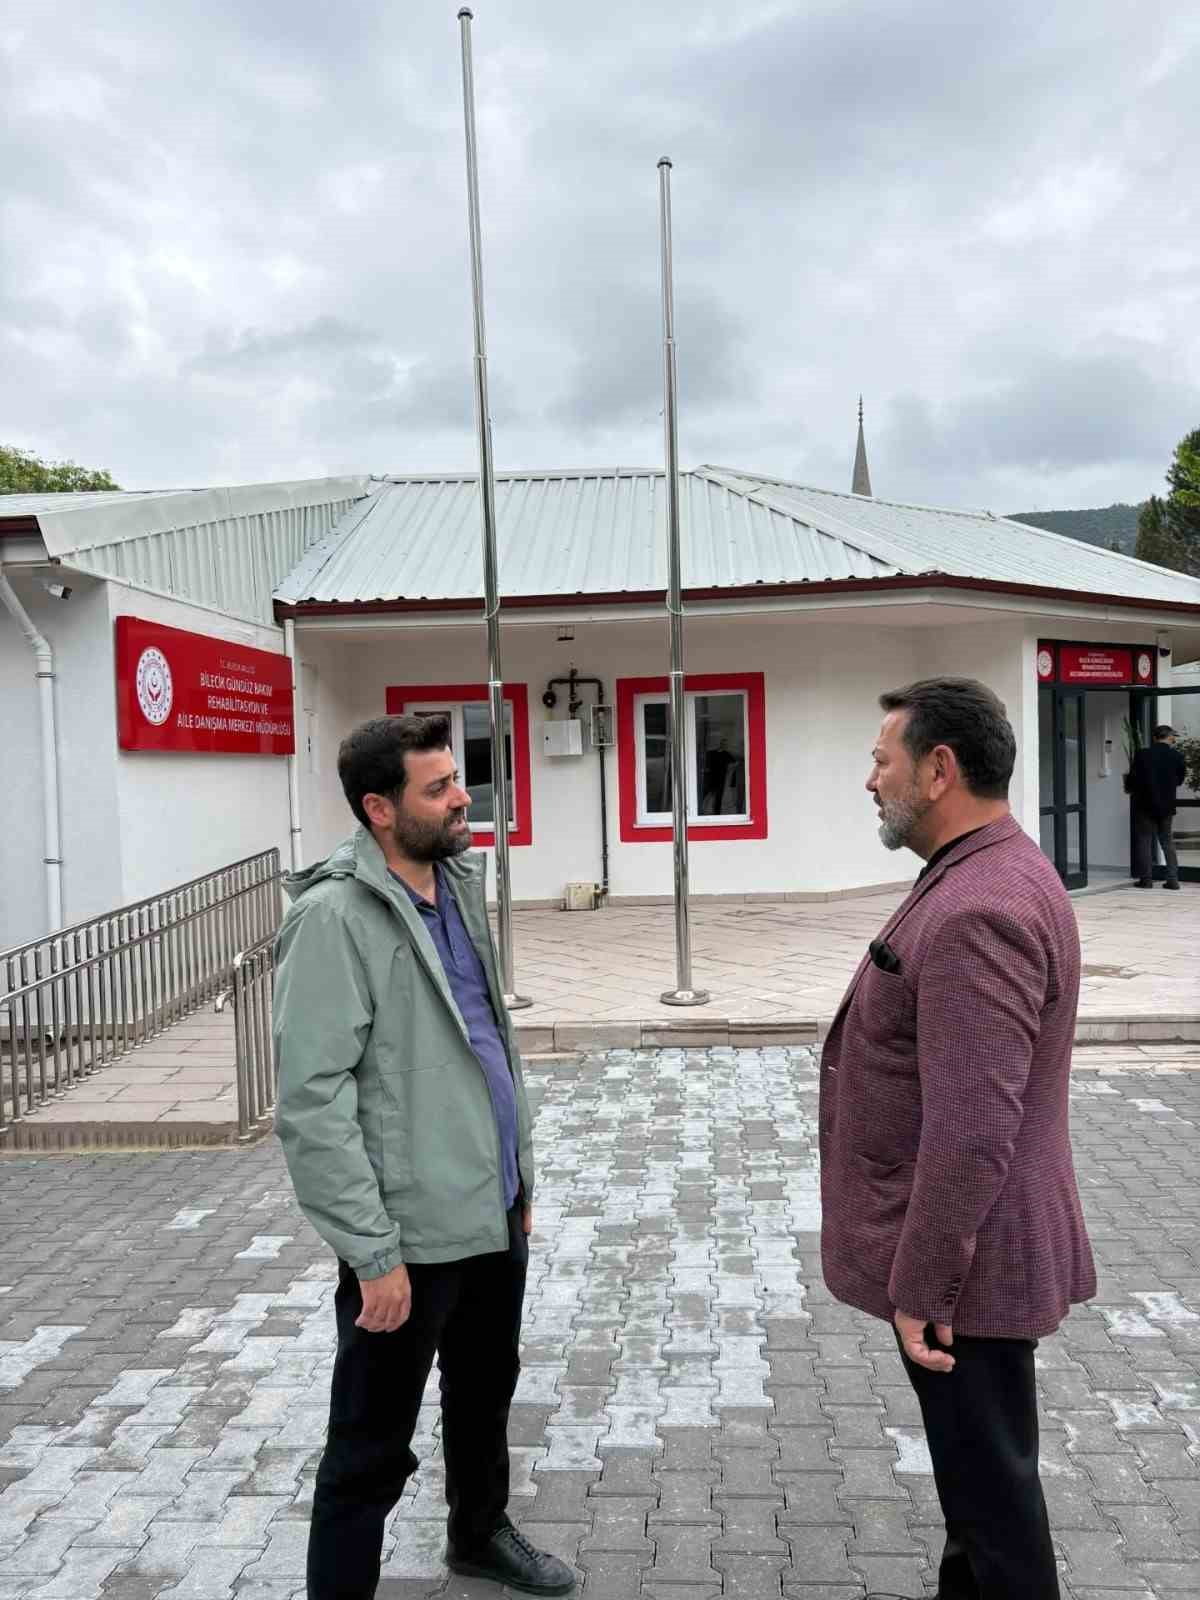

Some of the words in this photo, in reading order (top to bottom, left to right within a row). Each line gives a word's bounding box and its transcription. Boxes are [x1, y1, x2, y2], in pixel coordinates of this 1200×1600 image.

[200, 672, 225, 689] BİLECİK
[226, 677, 253, 694] GÜNDÜZ
[177, 714, 194, 728] AİLE
[195, 715, 227, 732] DANIŞMA
